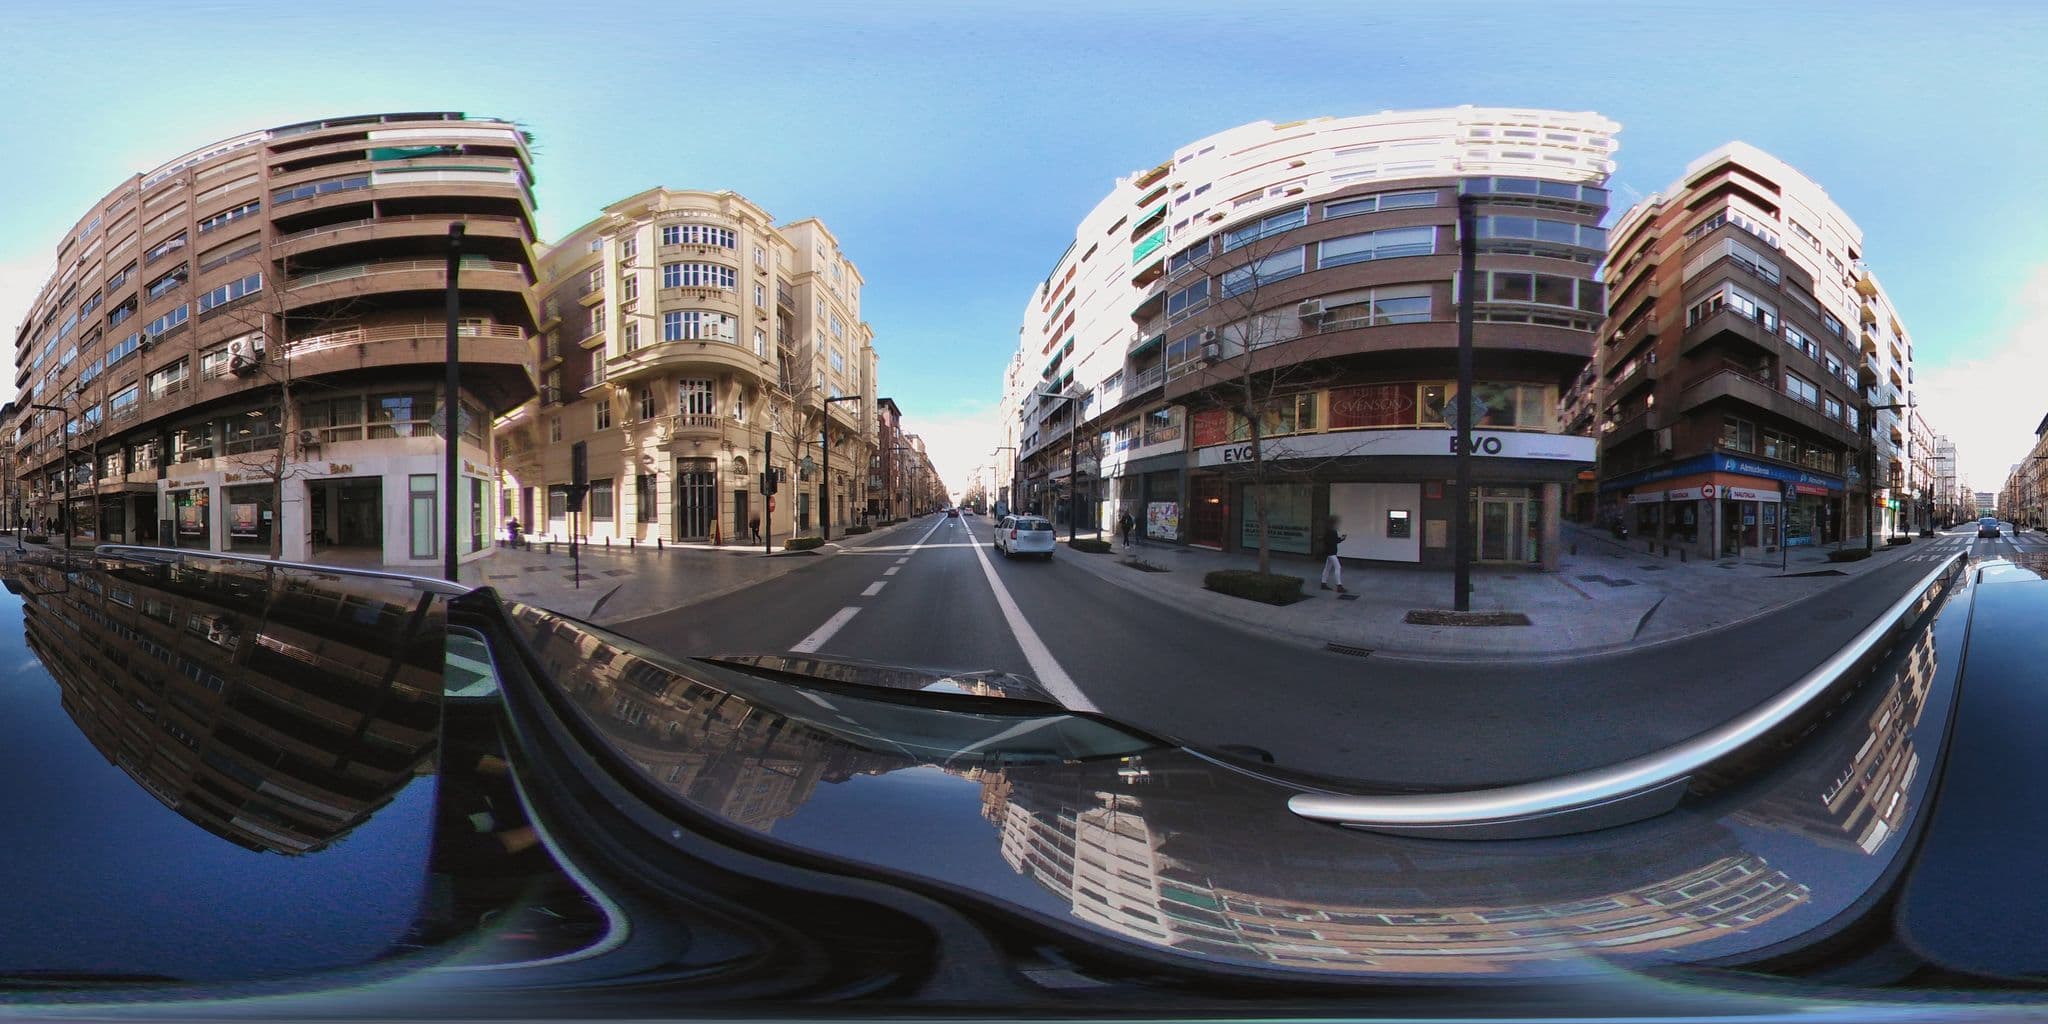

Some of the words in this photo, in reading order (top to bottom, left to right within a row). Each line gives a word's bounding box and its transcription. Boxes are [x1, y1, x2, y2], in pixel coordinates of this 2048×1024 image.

[1342, 397, 1403, 412] SVENSON
[1450, 436, 1502, 454] EVO
[1224, 446, 1254, 462] EVO
[1740, 463, 1770, 475] Almudena
